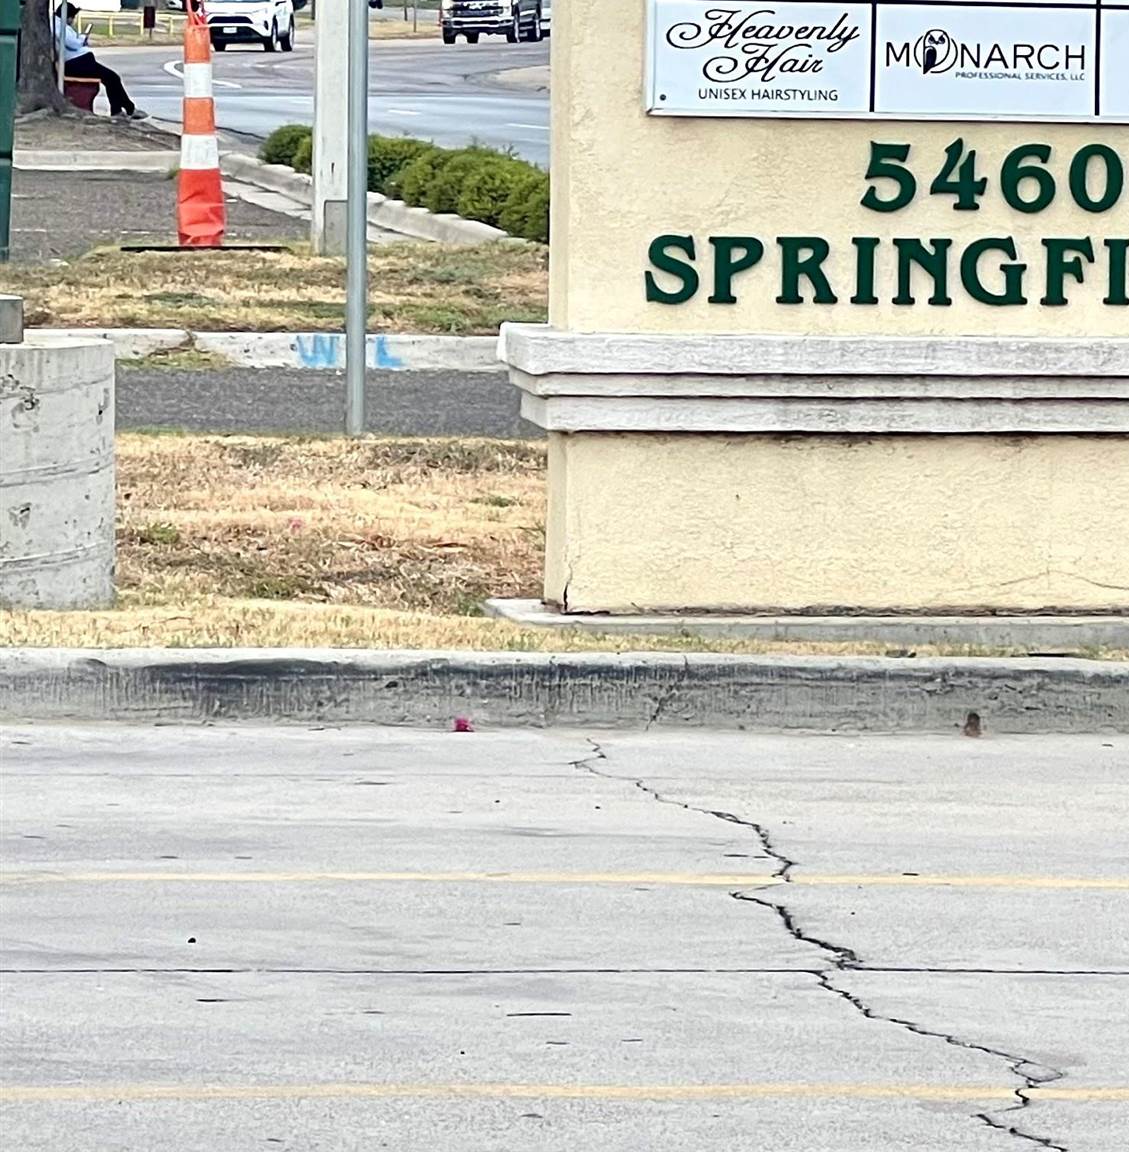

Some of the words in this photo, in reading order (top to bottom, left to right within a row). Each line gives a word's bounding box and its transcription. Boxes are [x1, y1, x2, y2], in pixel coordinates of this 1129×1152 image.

[665, 8, 861, 54] Heavenly
[885, 28, 1086, 75] MONARCH
[702, 42, 824, 83] Hair
[954, 71, 1022, 81] PROFESSIONAL
[1069, 73, 1086, 82] LLC
[697, 87, 748, 100] UNISEX
[750, 88, 839, 102] HAIRSTYLING
[859, 137, 1125, 214] 5460
